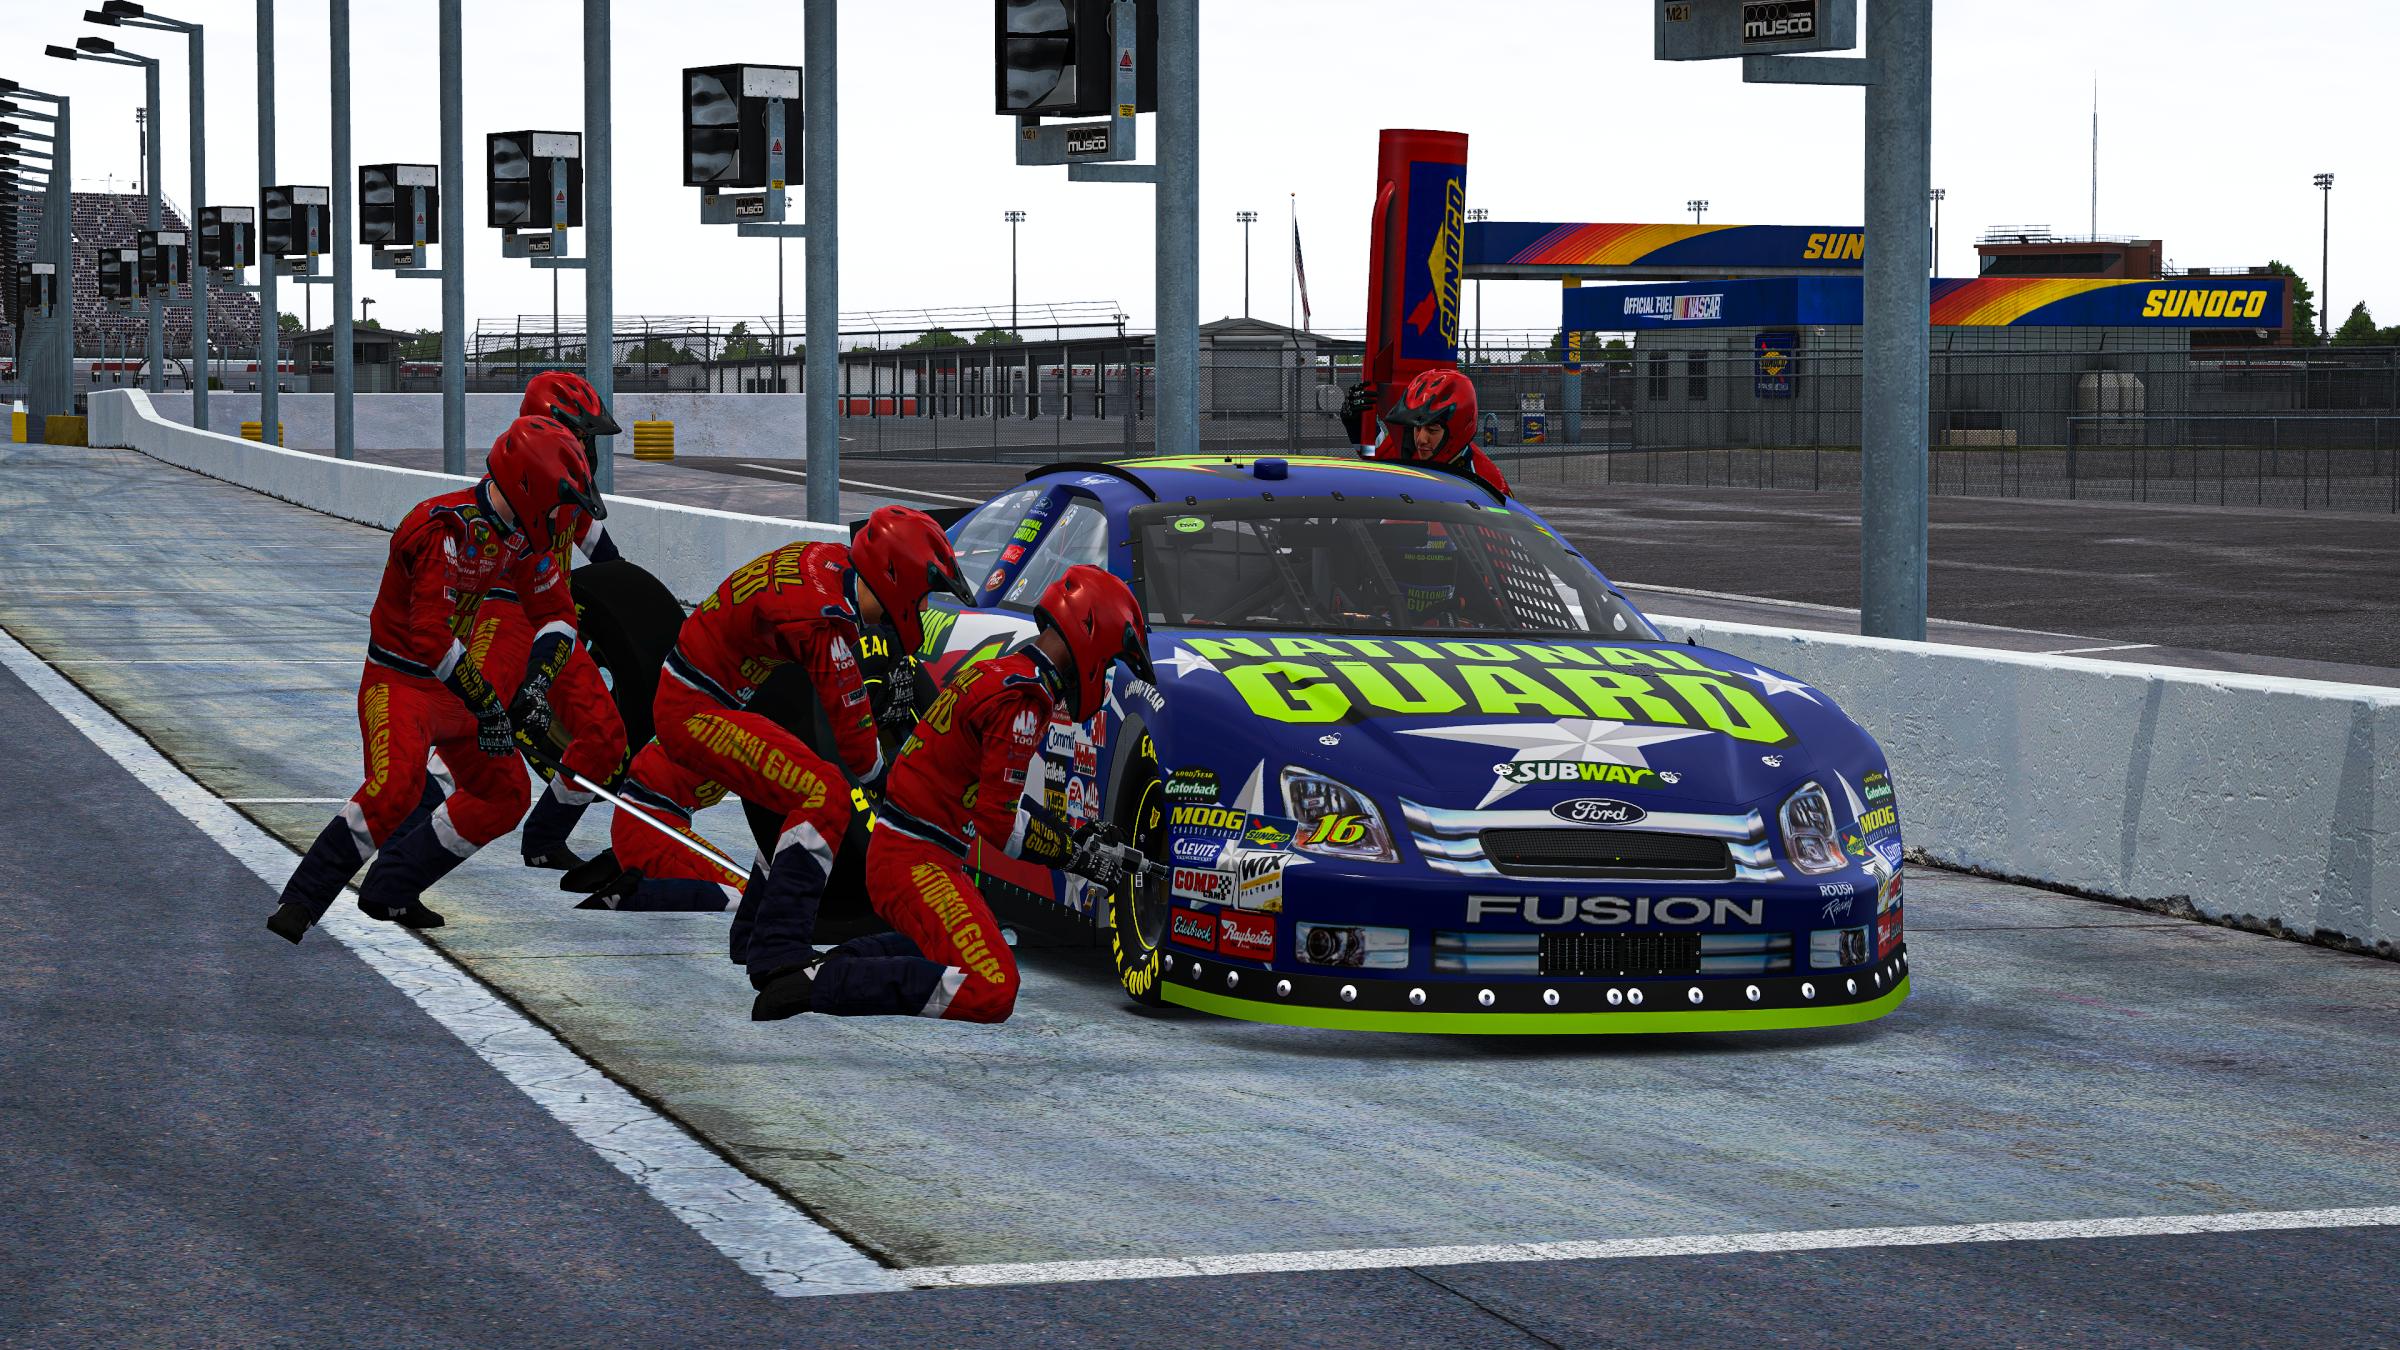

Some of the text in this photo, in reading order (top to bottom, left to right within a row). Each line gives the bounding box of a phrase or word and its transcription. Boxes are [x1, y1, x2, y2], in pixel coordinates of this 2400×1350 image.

[1745, 17, 1812, 38] MUSCO
[1068, 140, 1106, 152] MUSCO
[1440, 177, 1464, 346] SUNOCO
[1624, 296, 1673, 315] OFFICIAL FUEL
[1687, 296, 1721, 318] NASCAR
[2142, 289, 2267, 318] SUNOCO
[1182, 637, 1734, 677] NATIONAL
[1124, 679, 1165, 712] GOODYEAR
[1222, 661, 1789, 745] GUARD
[762, 747, 828, 809] GUARD
[1514, 761, 1656, 785] SUBWAY
[1165, 780, 1218, 796] Gatorback
[1170, 806, 1246, 831] MOOG
[1570, 800, 1629, 823] Ford
[1859, 805, 1896, 834] MOOG
[1172, 825, 1240, 840] CHASSIS PARTS
[1246, 830, 1290, 841] SUNOCO
[1304, 813, 1370, 846] 16
[1173, 837, 1220, 858] CLEVITE
[1242, 854, 1286, 881] WIX
[1174, 869, 1219, 893] COMP
[1241, 881, 1280, 897] FILTERS
[1819, 884, 1854, 896] ROUSH
[1202, 889, 1227, 901] CAMS
[1465, 894, 1765, 925] FUSION
[1173, 915, 1212, 943] Edelbrock
